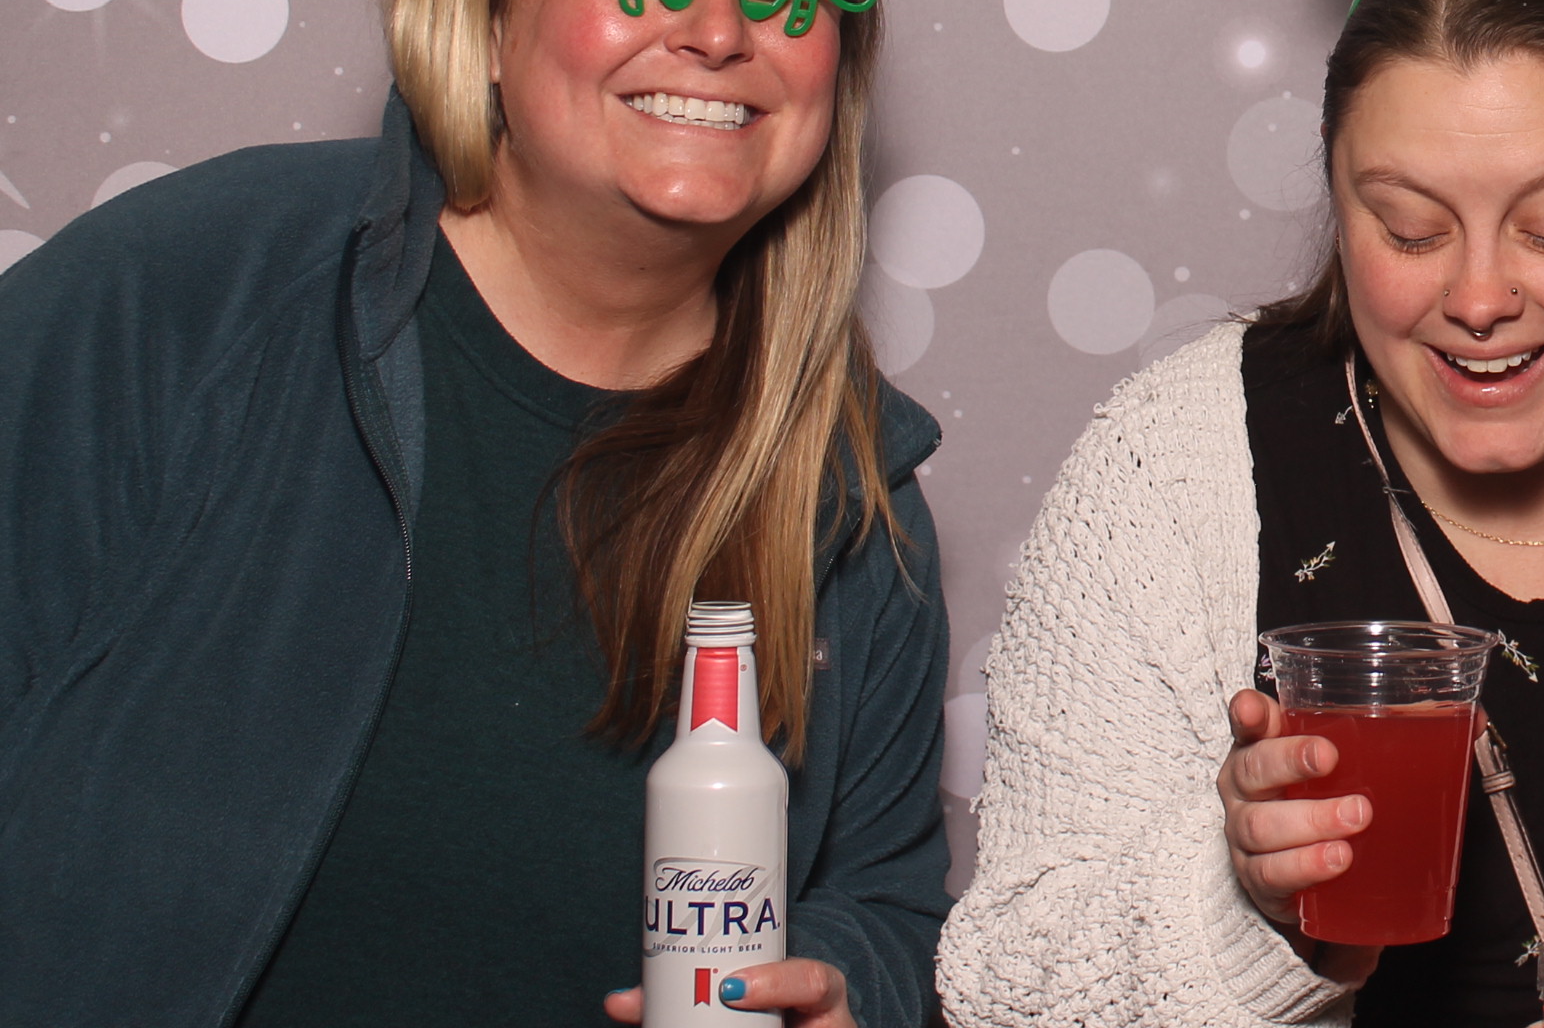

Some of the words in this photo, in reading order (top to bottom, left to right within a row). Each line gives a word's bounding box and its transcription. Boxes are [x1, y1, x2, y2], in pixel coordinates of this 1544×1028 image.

[655, 867, 759, 892] Michelob
[645, 895, 778, 935] ULTRA
[652, 942, 696, 953] SUPERIOR
[738, 943, 763, 952] BEER
